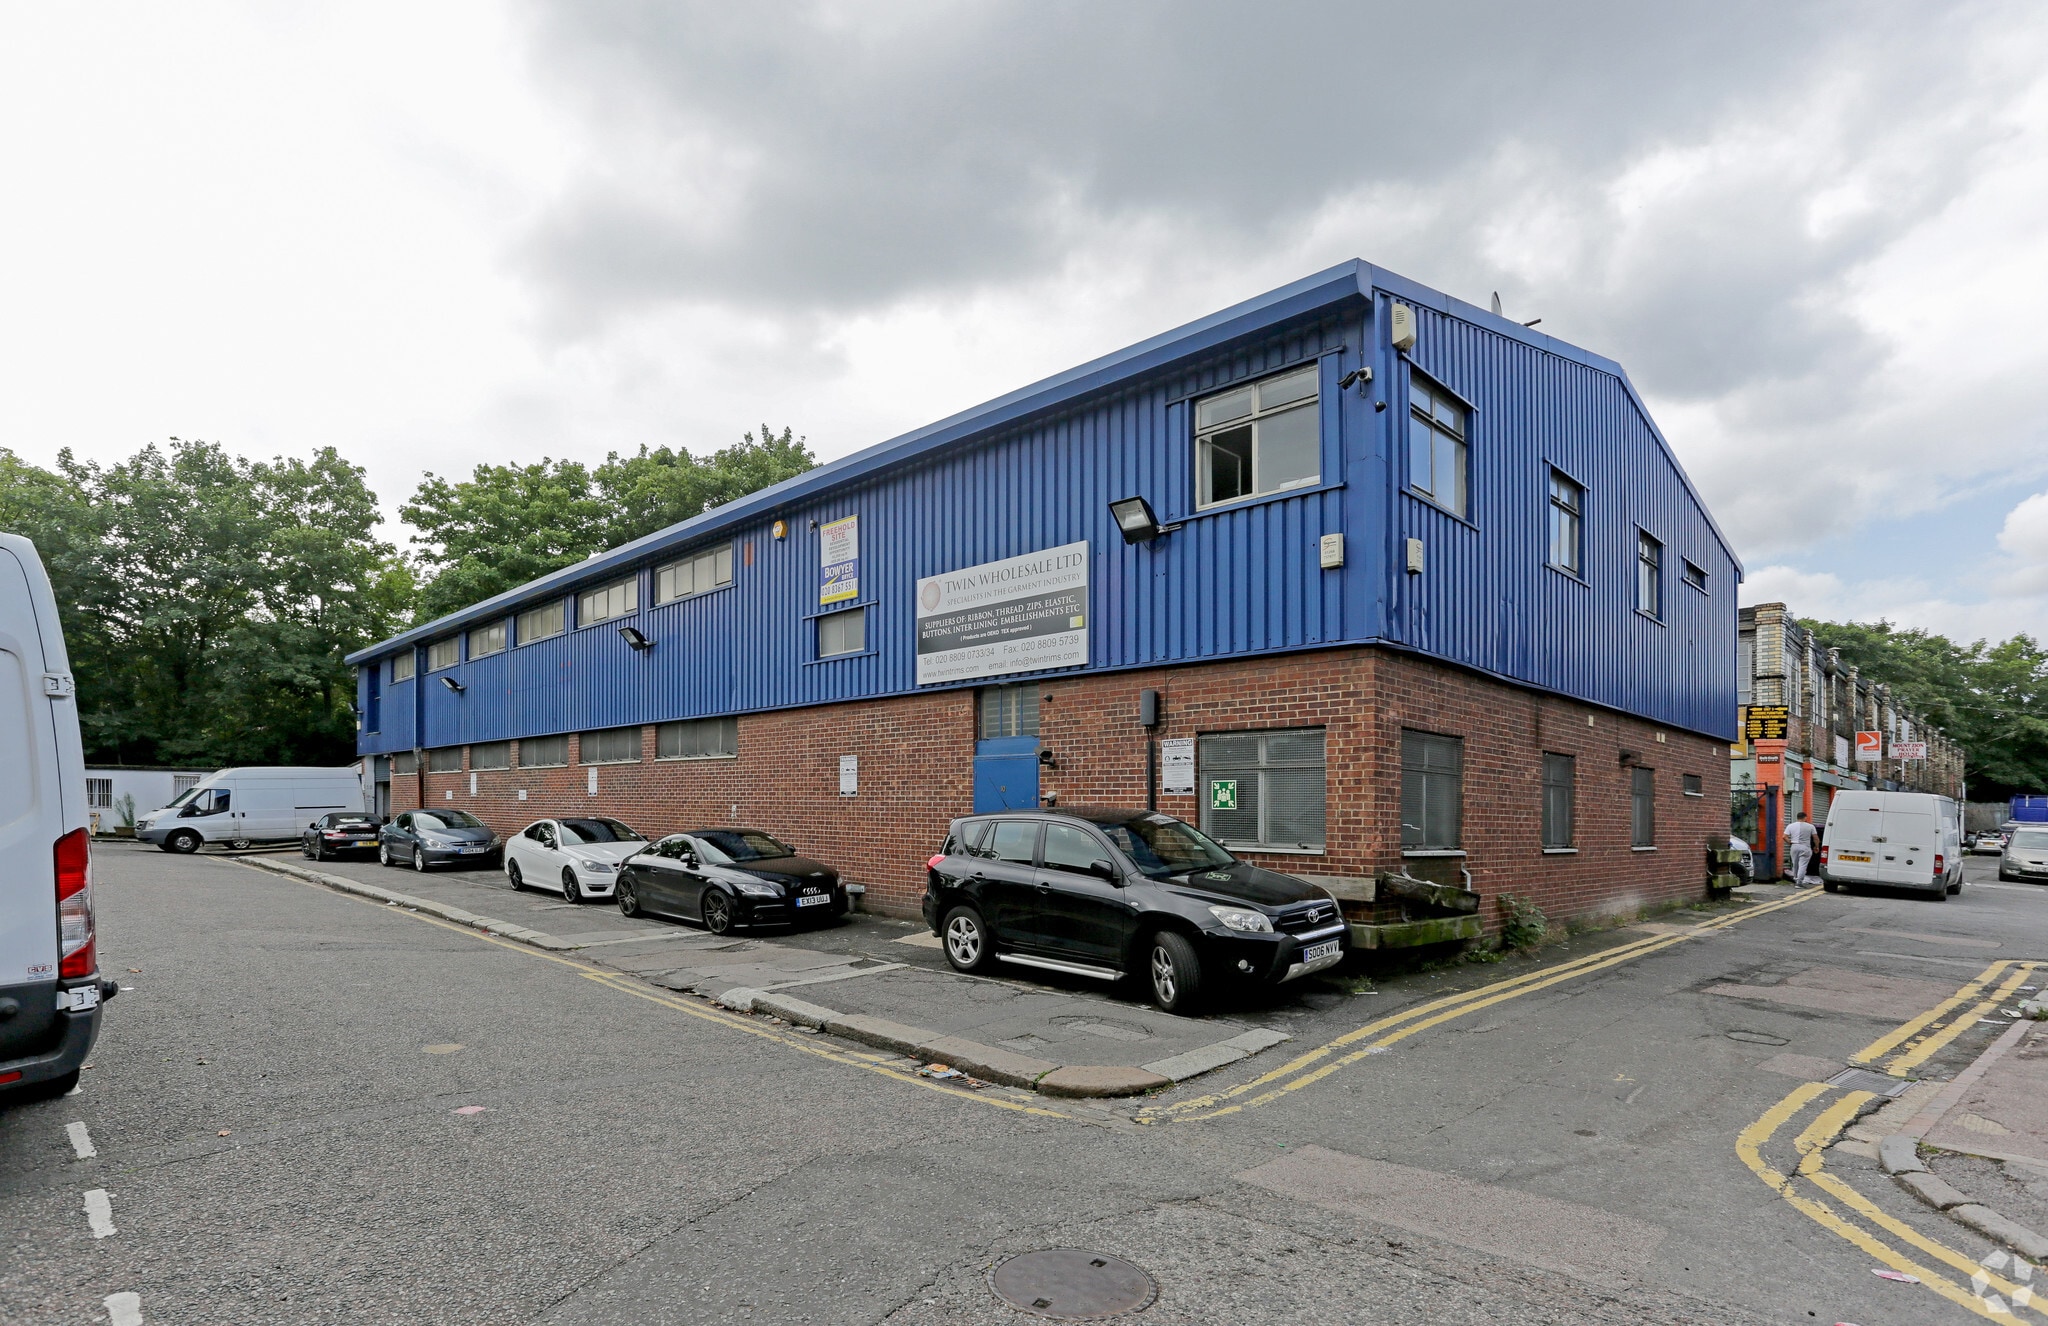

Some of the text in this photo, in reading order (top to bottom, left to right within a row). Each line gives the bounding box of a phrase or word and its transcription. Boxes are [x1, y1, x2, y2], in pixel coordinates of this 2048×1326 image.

[822, 522, 855, 537] FREEHOLD
[832, 532, 846, 542] SITE
[825, 562, 853, 578] BOWYER
[945, 553, 1083, 593] TWIN WHOLESALE LTD
[947, 593, 983, 606] SPECIALISTS
[994, 588, 1006, 596] THE
[1008, 580, 1041, 594] GARMENT
[1044, 573, 1080, 587] INDUSTRY
[925, 617, 955, 630] SUPPLIERS
[996, 604, 1024, 617] THREAD
[1000, 606, 1064, 625] EMBELLISHMENTS
[1066, 604, 1080, 614] ETC
[1004, 634, 1079, 654] Fax: 020 8809 5739
[923, 647, 994, 666] Tel: 020 8809 0733/34
[988, 651, 1080, 670] email: info@twintrims.com
[922, 665, 979, 678] www.twintrims.com
[1163, 739, 1192, 747] WARNING
